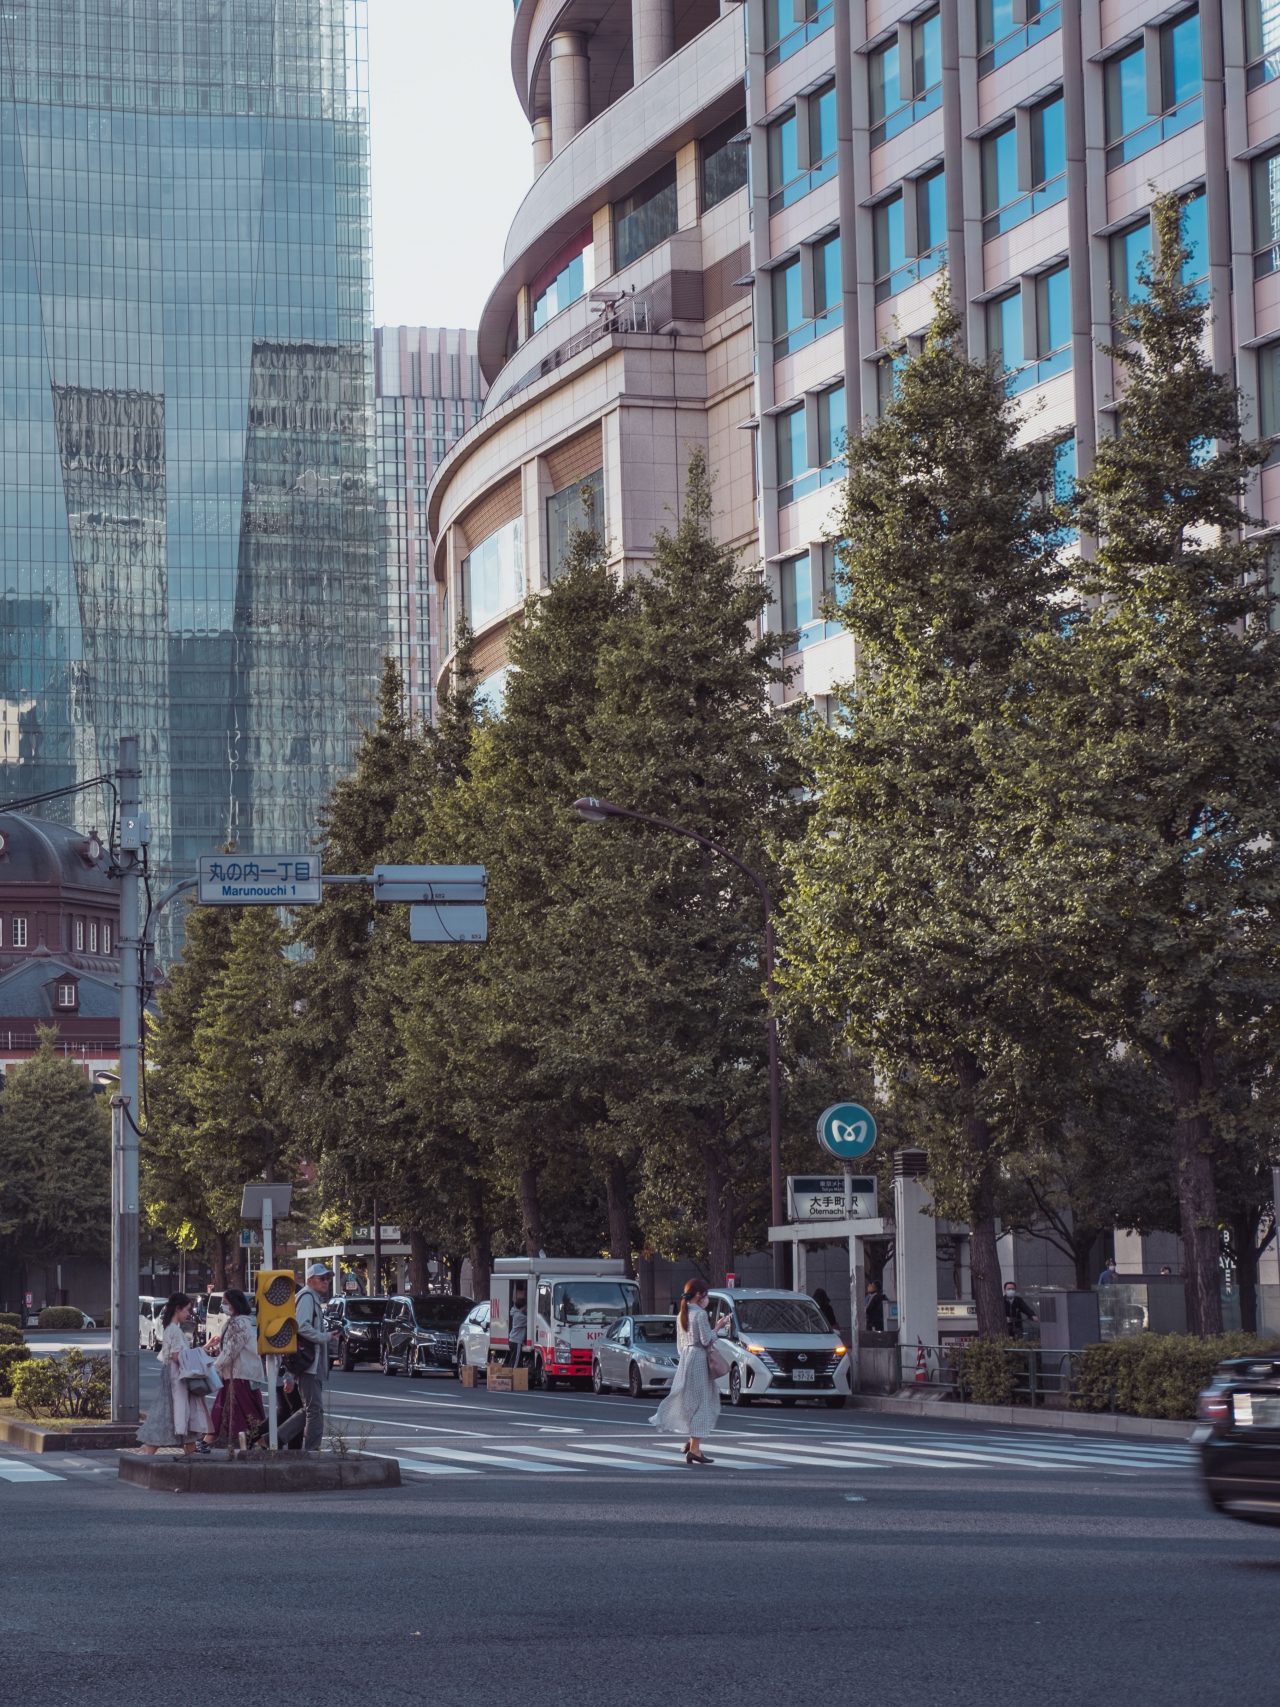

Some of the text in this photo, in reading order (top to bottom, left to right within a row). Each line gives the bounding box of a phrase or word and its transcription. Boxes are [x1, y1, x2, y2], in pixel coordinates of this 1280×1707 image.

[209, 861, 310, 882] 丸の内一丁目
[222, 885, 296, 896] Marunouchi 1
[355, 1228, 368, 1236] JR
